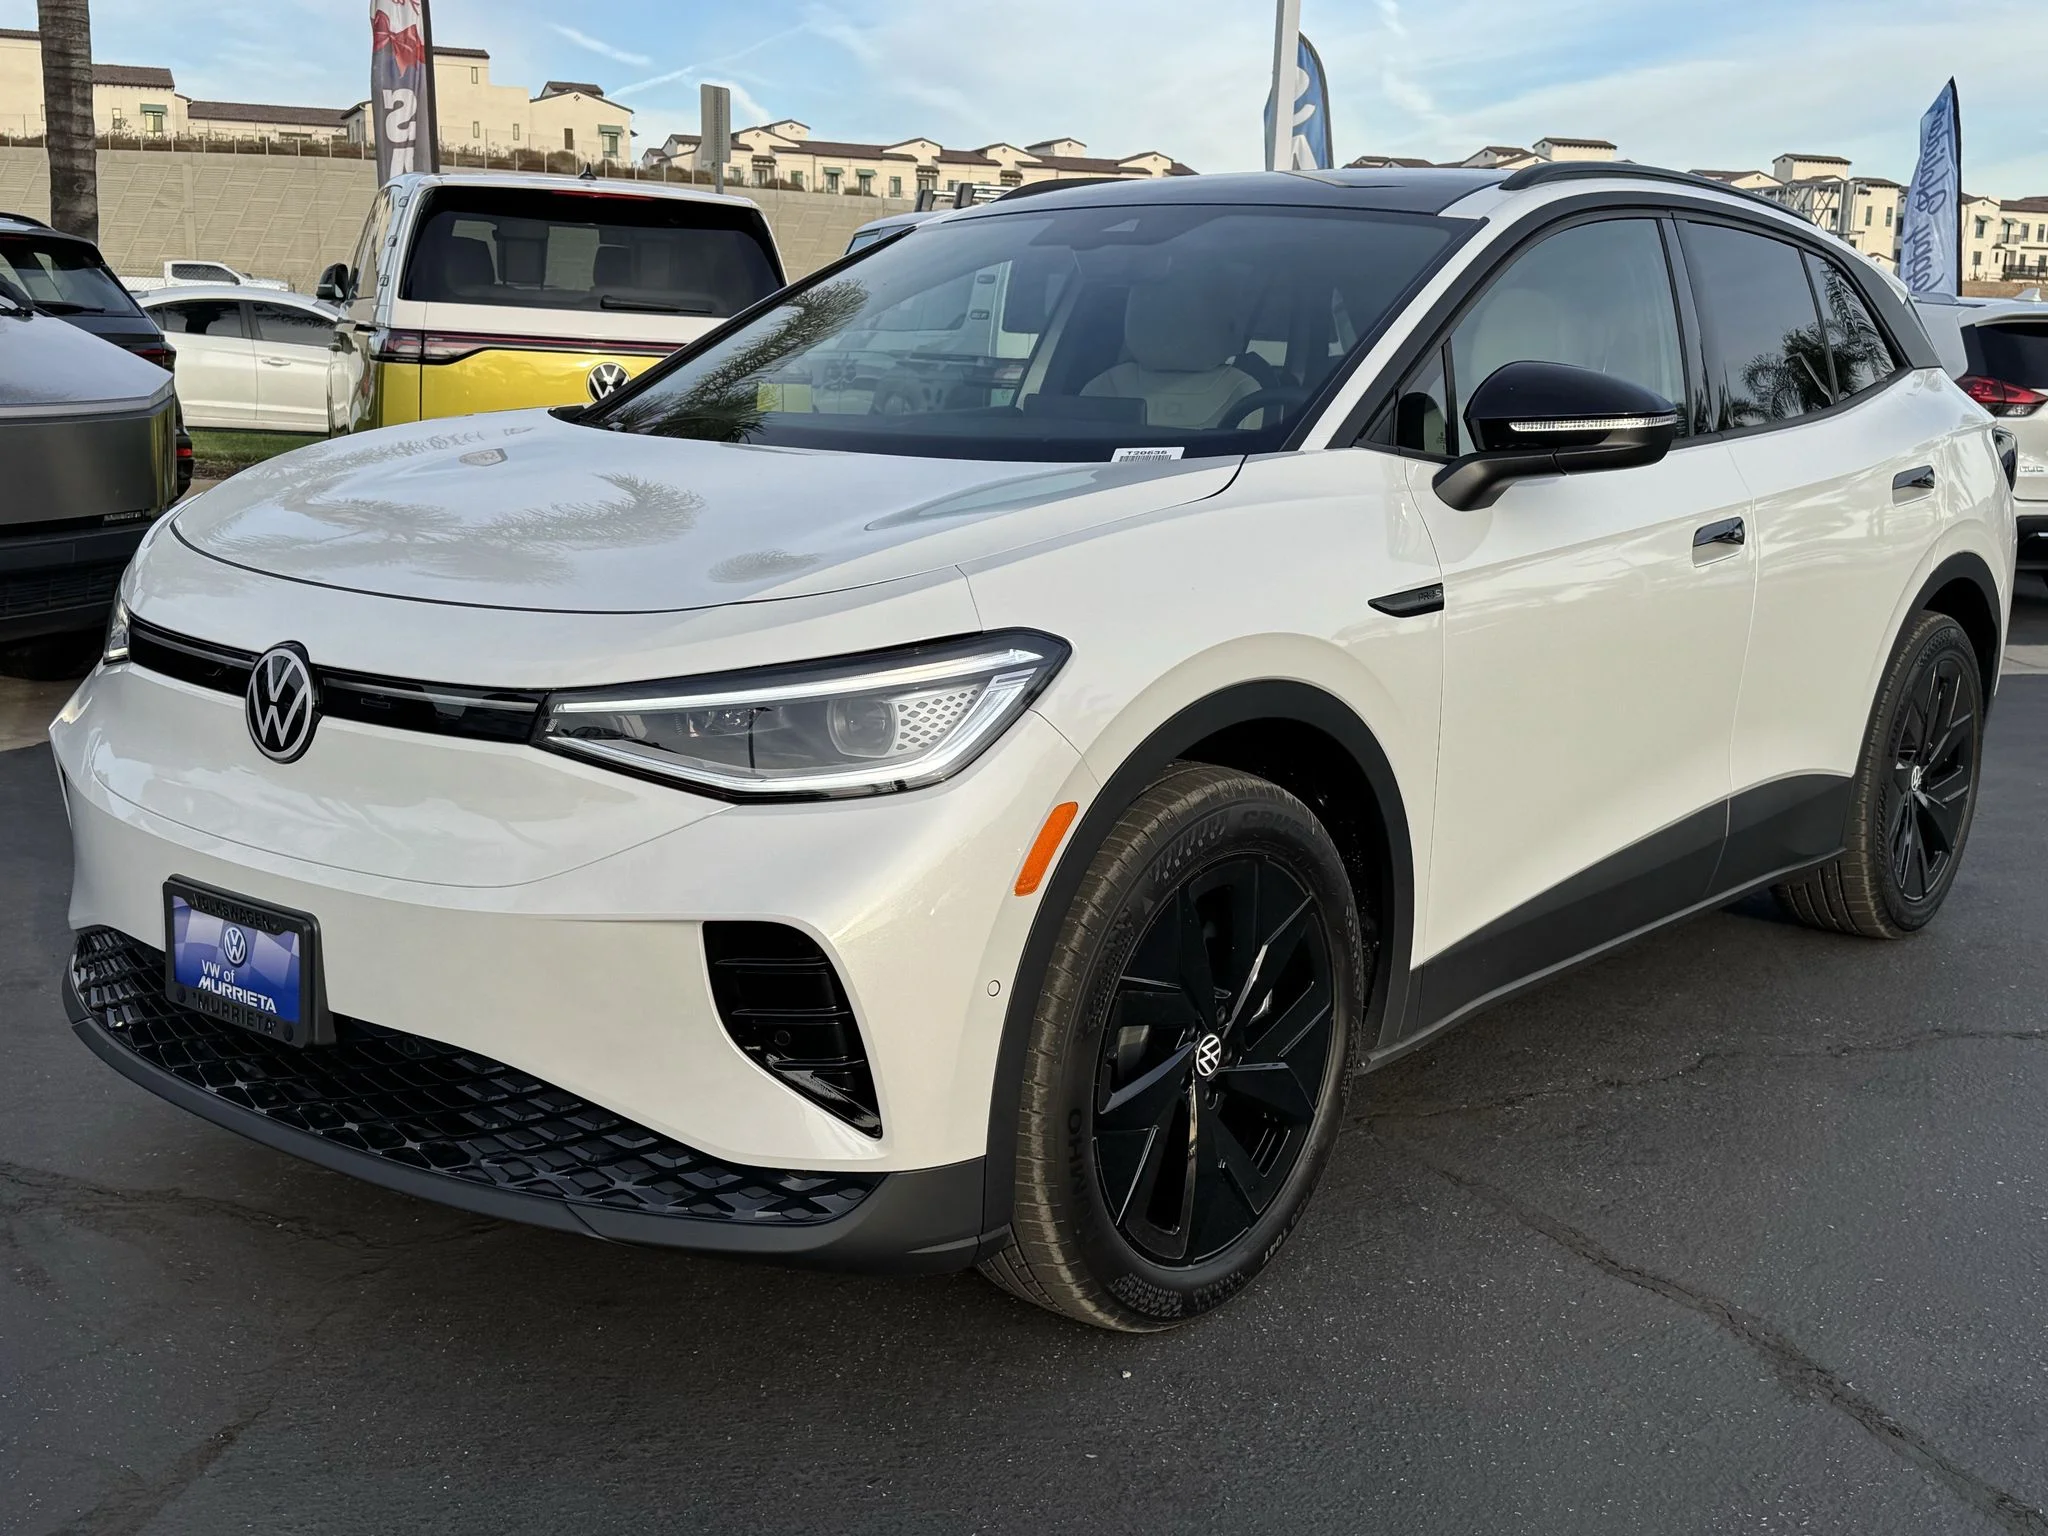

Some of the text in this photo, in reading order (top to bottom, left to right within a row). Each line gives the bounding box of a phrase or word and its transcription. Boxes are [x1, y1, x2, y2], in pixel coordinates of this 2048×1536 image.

[191, 893, 273, 930] VOLKSWAGEN
[201, 959, 235, 983] VW of
[196, 991, 273, 1034] MURRIETA
[198, 975, 277, 1014] MURRIETA
